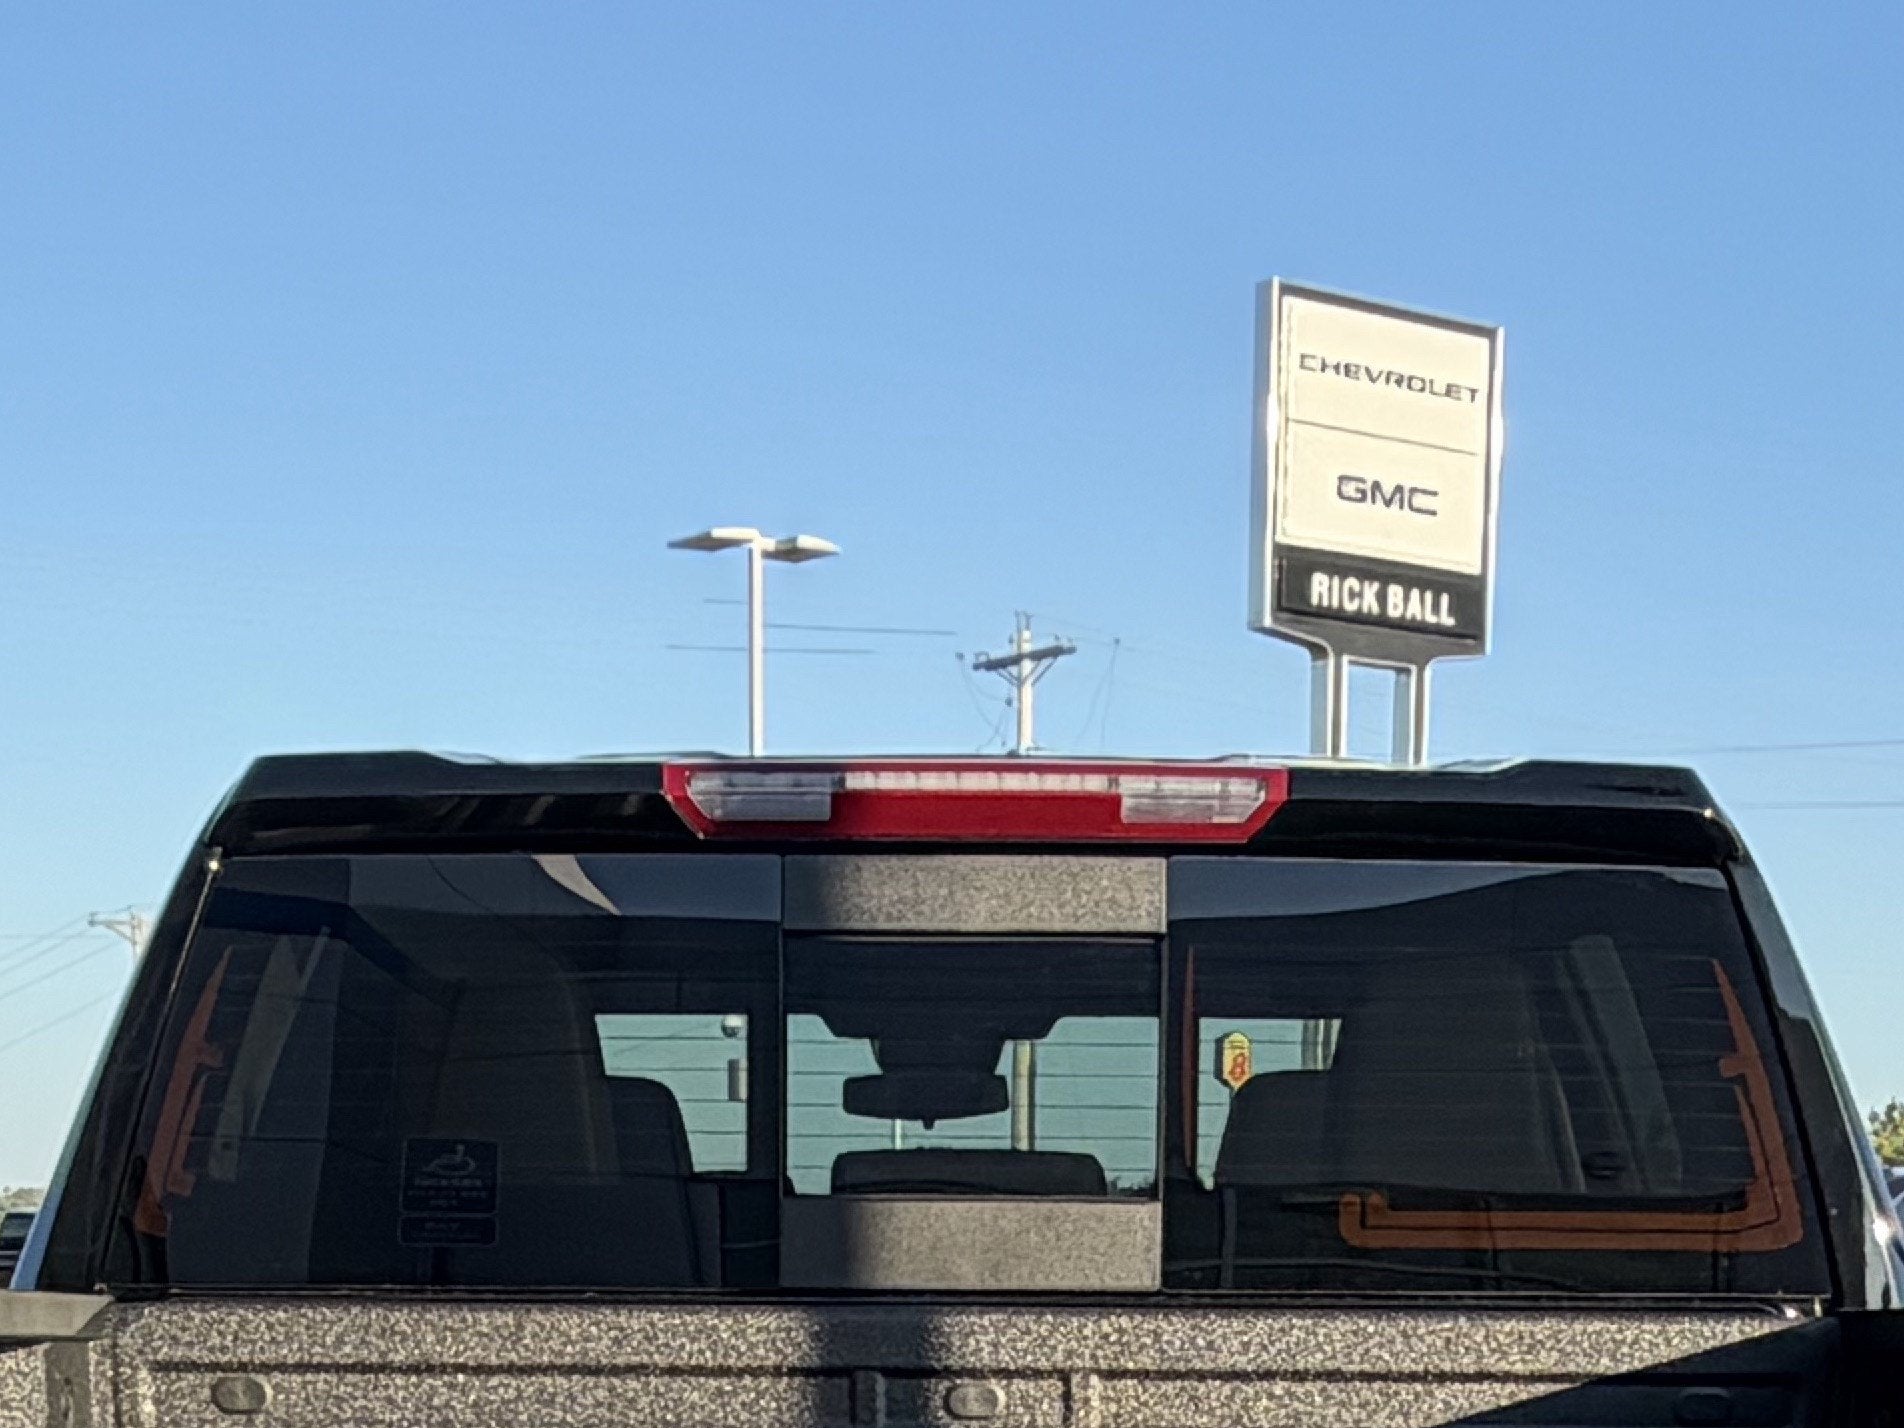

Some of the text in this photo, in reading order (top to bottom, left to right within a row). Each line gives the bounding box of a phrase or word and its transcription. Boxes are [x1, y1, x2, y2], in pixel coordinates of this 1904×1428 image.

[1298, 352, 1480, 404] CHEVROLET
[1336, 473, 1439, 517] GMC
[1310, 571, 1457, 627] RICK BALL
